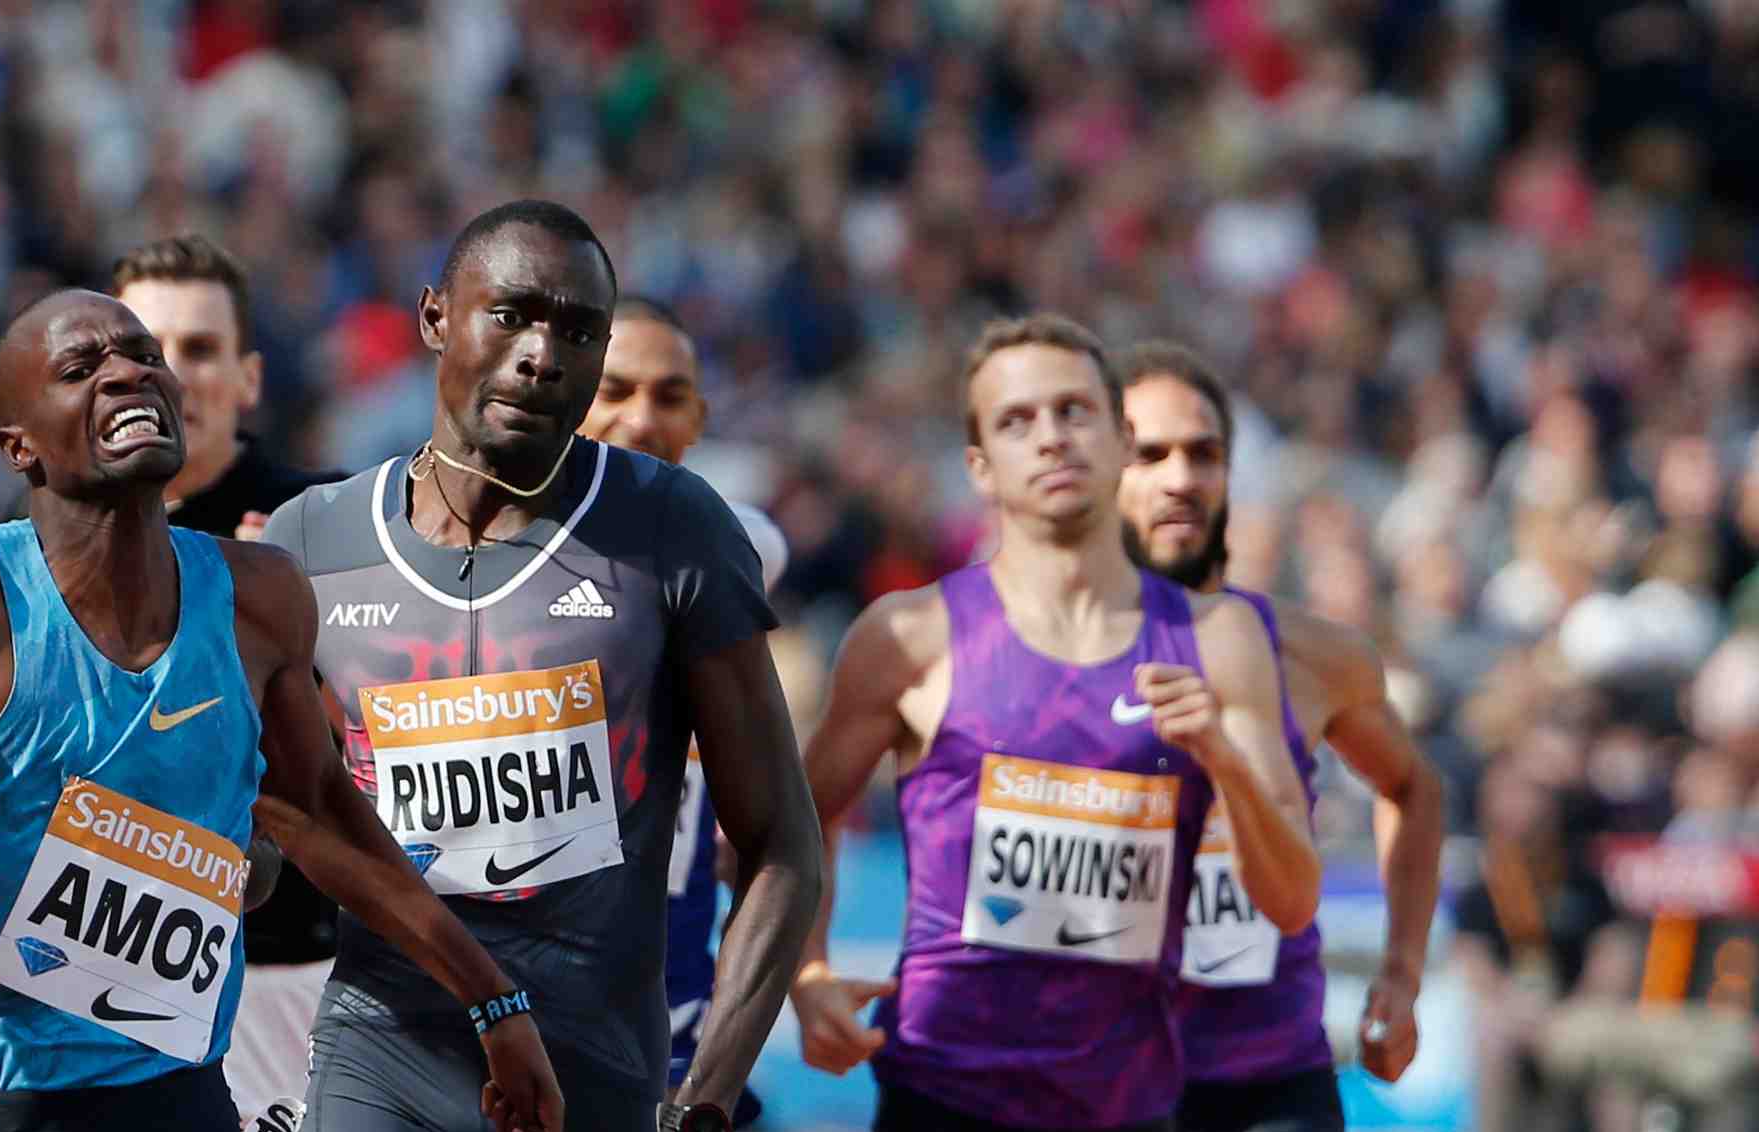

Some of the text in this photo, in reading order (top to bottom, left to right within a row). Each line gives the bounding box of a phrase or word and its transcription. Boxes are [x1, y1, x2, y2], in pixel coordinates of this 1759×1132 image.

[326, 602, 401, 627] AKTIV
[548, 600, 615, 619] adidas
[371, 675, 594, 733] Sainsbury's
[390, 742, 601, 832] RUDISHA
[991, 764, 1172, 822] Sainsbury's
[67, 792, 251, 899] Sainsbury's
[988, 827, 1164, 903] SOWINSKI
[27, 861, 226, 994] AMOS
